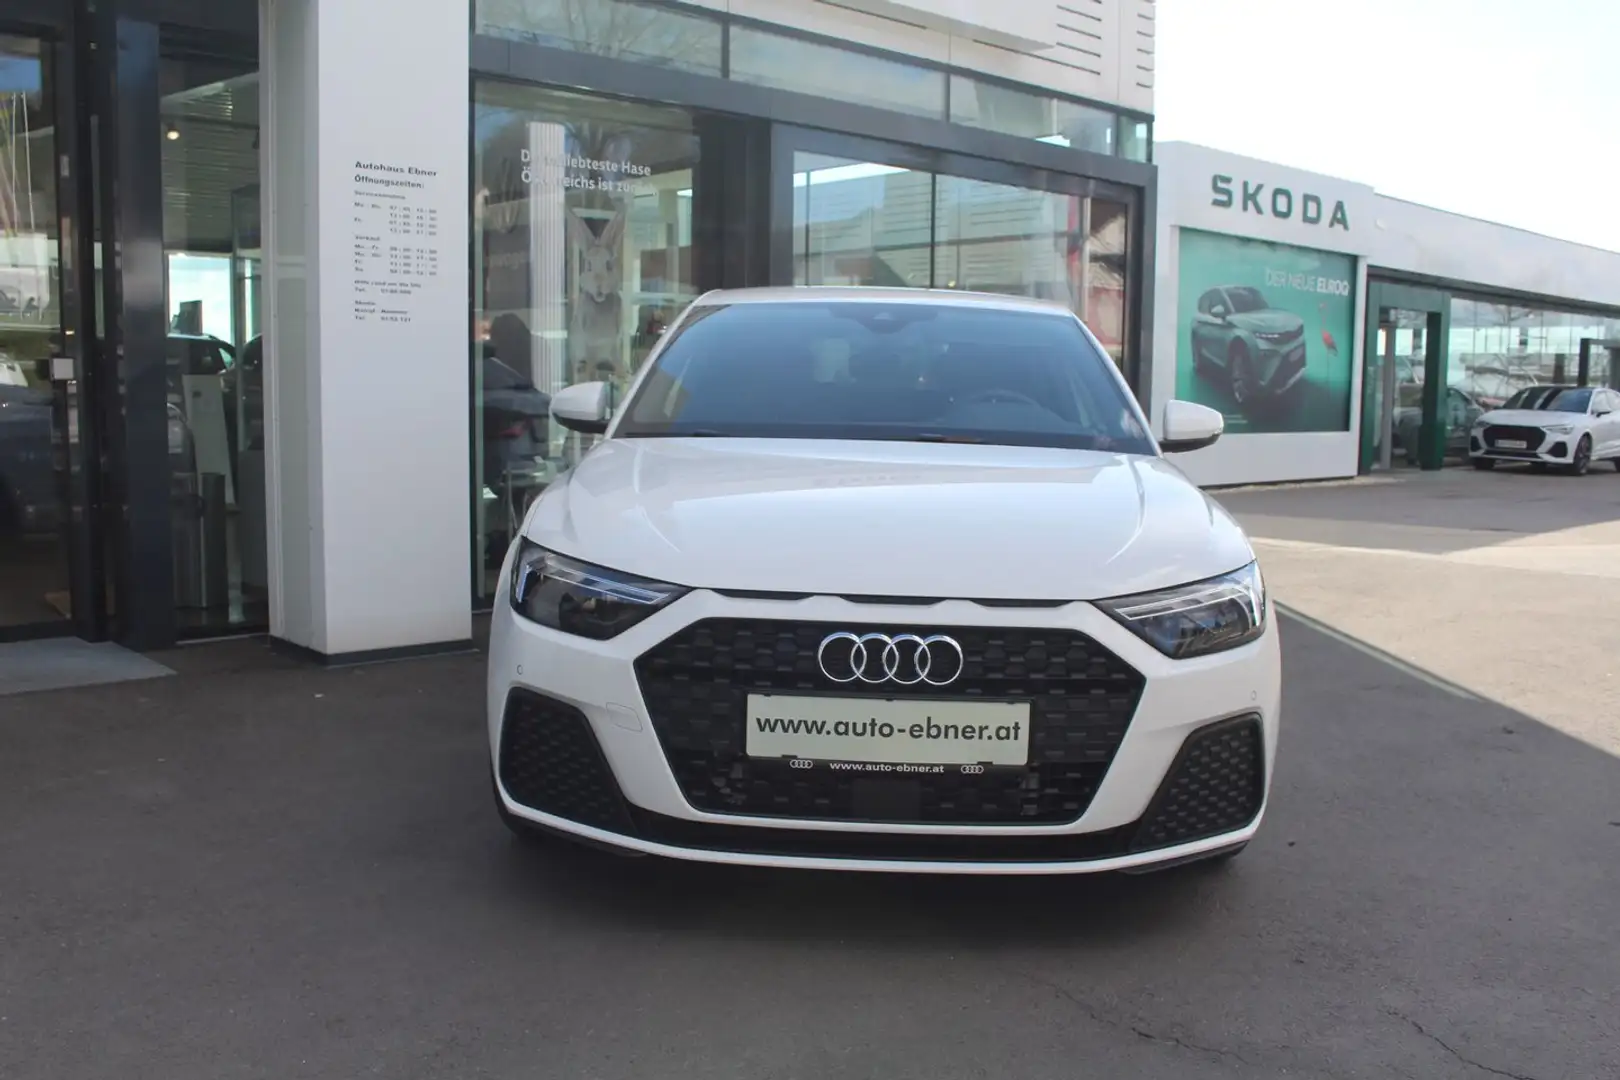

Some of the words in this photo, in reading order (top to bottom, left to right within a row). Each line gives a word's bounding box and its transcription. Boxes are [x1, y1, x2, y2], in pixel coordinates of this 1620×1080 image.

[355, 161, 405, 173] Autohaus
[408, 166, 437, 177] Ebner
[521, 166, 596, 190] Öeichs
[598, 176, 613, 191] ist
[621, 160, 652, 177] Hase
[354, 174, 424, 189] Öffnungszeiten:
[1211, 173, 1350, 232] SKODA
[1265, 267, 1286, 290] DER
[755, 716, 1021, 741] www.auto-ebner.at
[829, 760, 945, 774] www.auto-ebner.at
